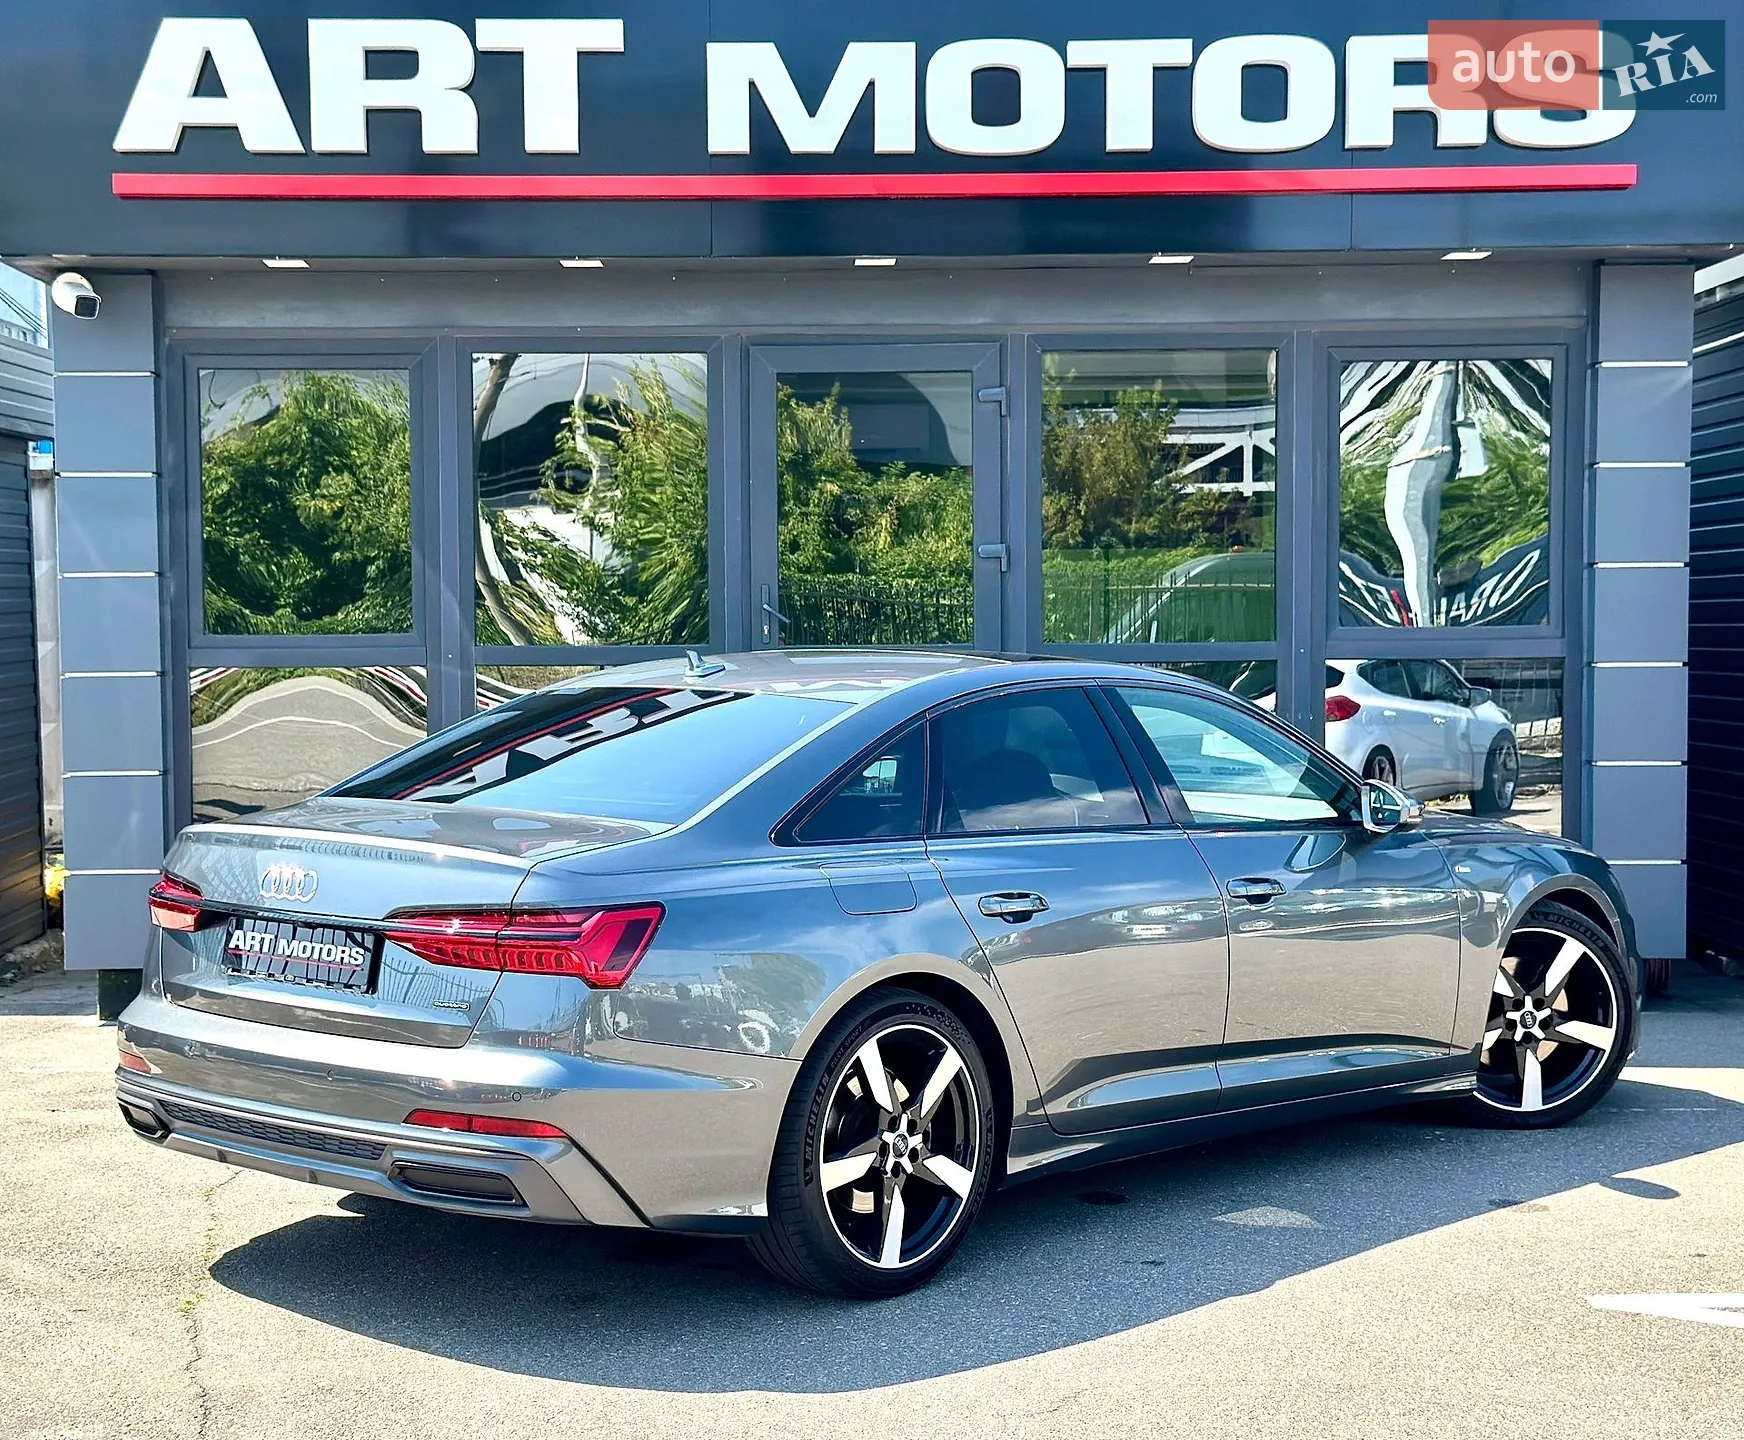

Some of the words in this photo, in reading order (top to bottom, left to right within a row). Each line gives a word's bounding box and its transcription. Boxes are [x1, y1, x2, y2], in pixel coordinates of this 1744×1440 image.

[112, 17, 625, 155] ART
[706, 30, 1637, 156] MOTORS
[228, 930, 276, 953] ART
[278, 938, 365, 965] MOTORS
[805, 1071, 829, 1162] MICHELIN
